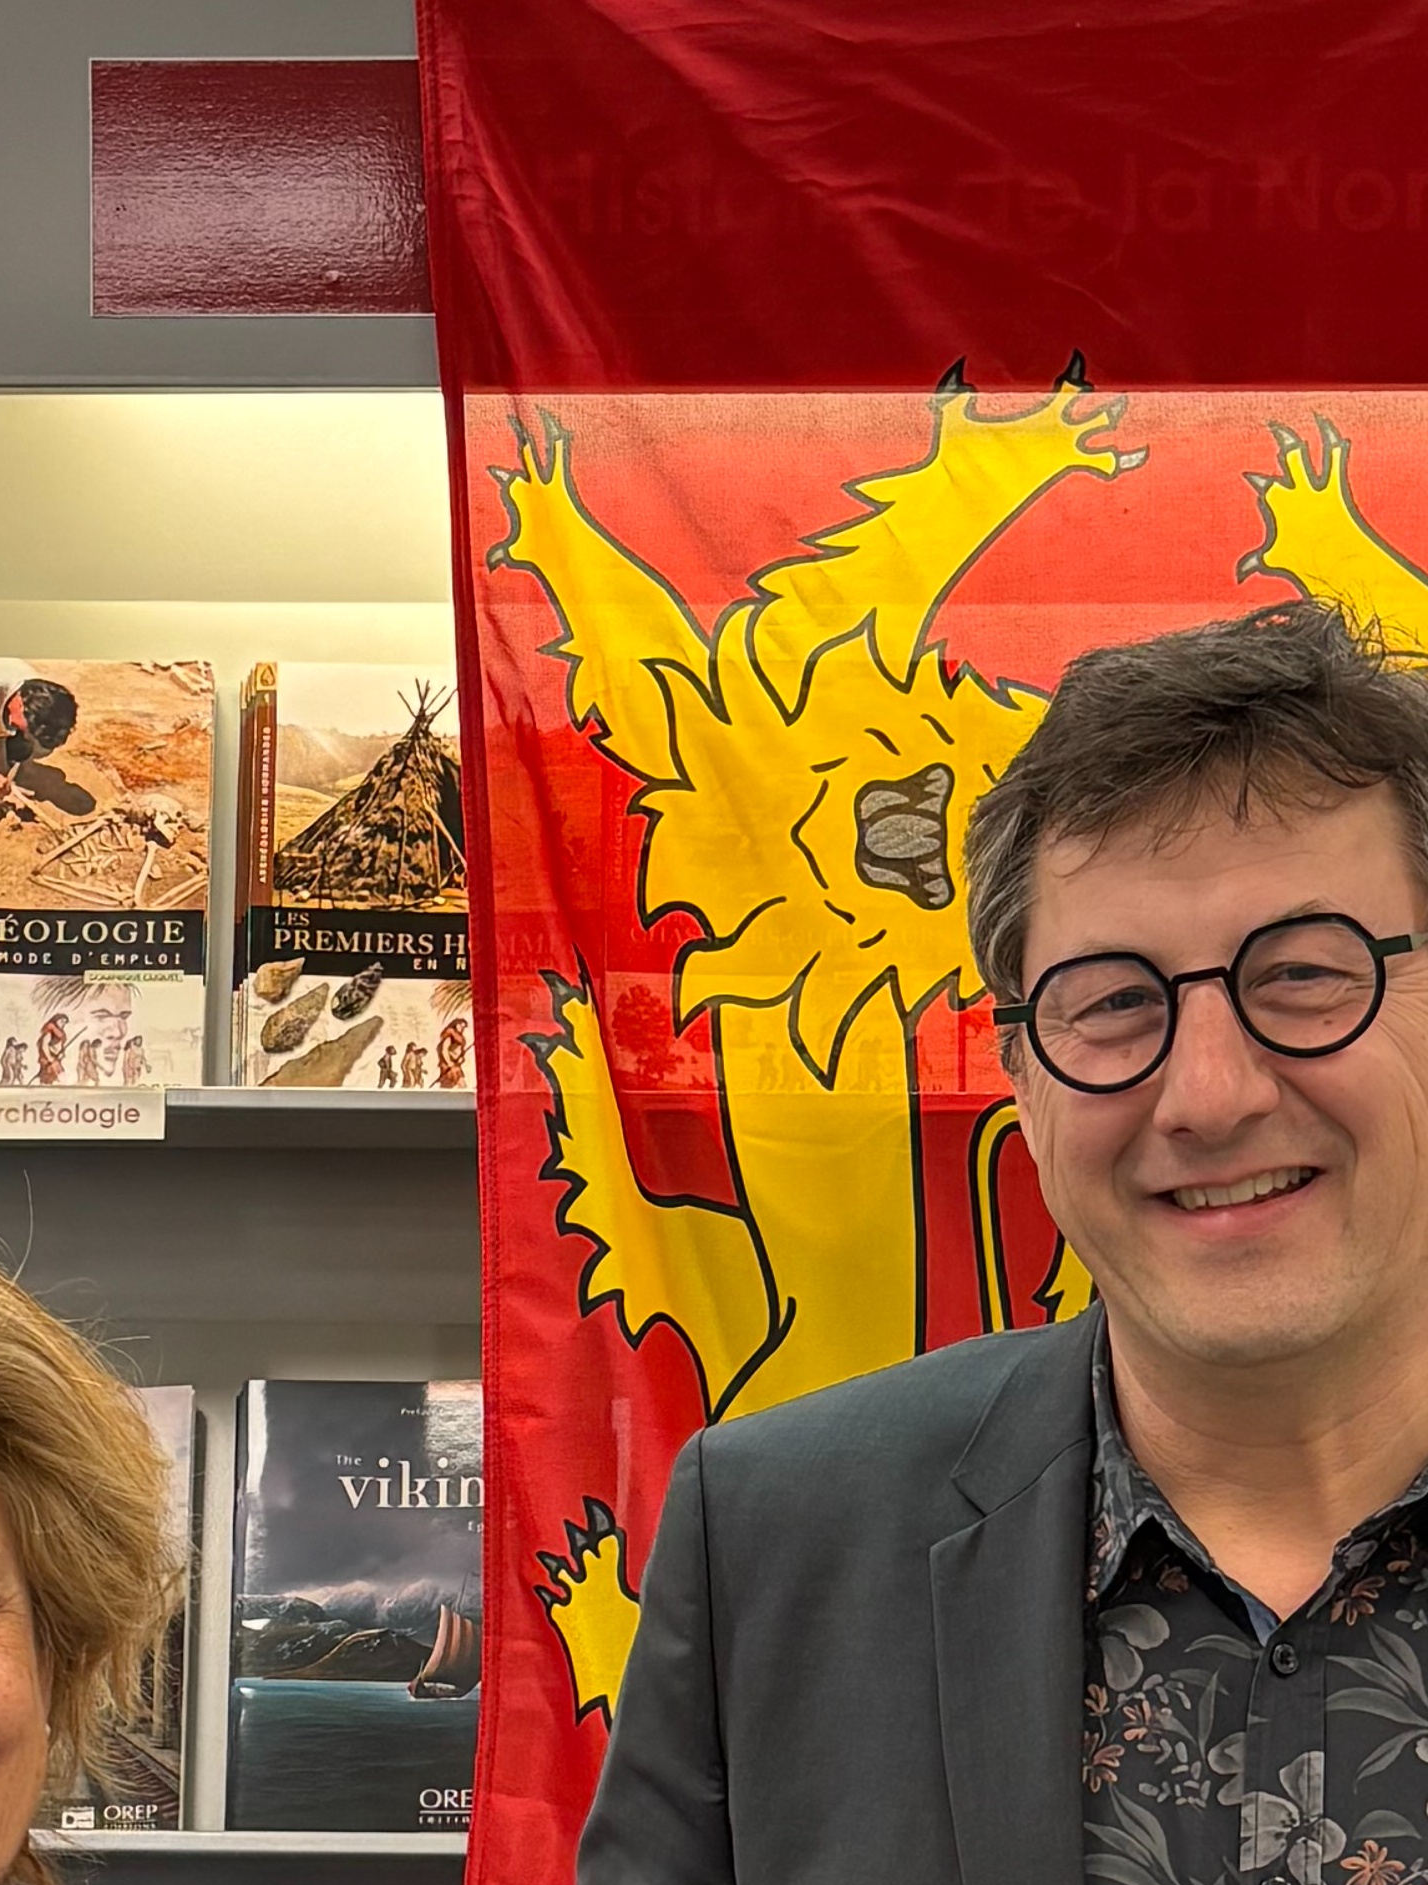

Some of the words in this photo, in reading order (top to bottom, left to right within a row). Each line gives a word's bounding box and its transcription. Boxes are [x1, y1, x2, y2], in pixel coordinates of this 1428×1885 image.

[274, 911, 310, 927] LES
[274, 928, 434, 956] PREMIERS
[72, 951, 181, 966] D'EMPLOI
[414, 958, 437, 971] EN
[103, 1804, 158, 1821] OREP
